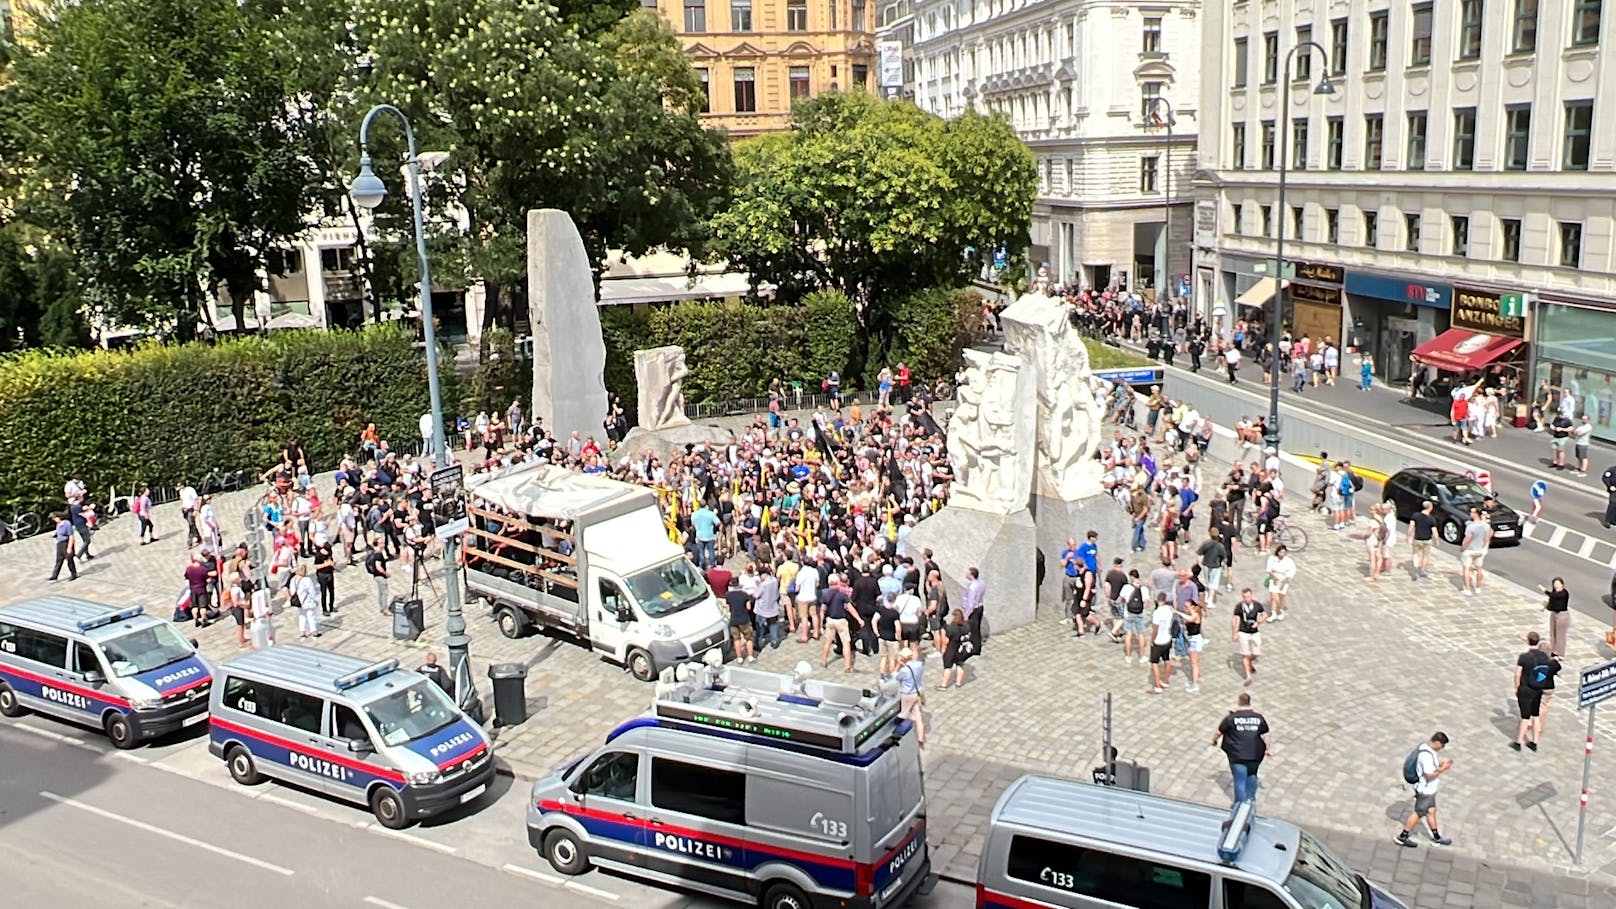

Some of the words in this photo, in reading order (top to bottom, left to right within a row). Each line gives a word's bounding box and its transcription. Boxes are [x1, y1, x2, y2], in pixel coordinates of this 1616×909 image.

[1459, 294, 1501, 312] BONBO
[1457, 308, 1521, 330] ANZINGER
[155, 666, 200, 686] POLIZEI
[41, 685, 87, 709] POLIZEI
[430, 732, 473, 757] POLIZEI
[289, 751, 347, 781] POLIZEI
[821, 819, 848, 837] 133
[655, 832, 722, 859] POLIZEI
[889, 837, 918, 874] POLIZEI
[1051, 871, 1075, 889] 133
